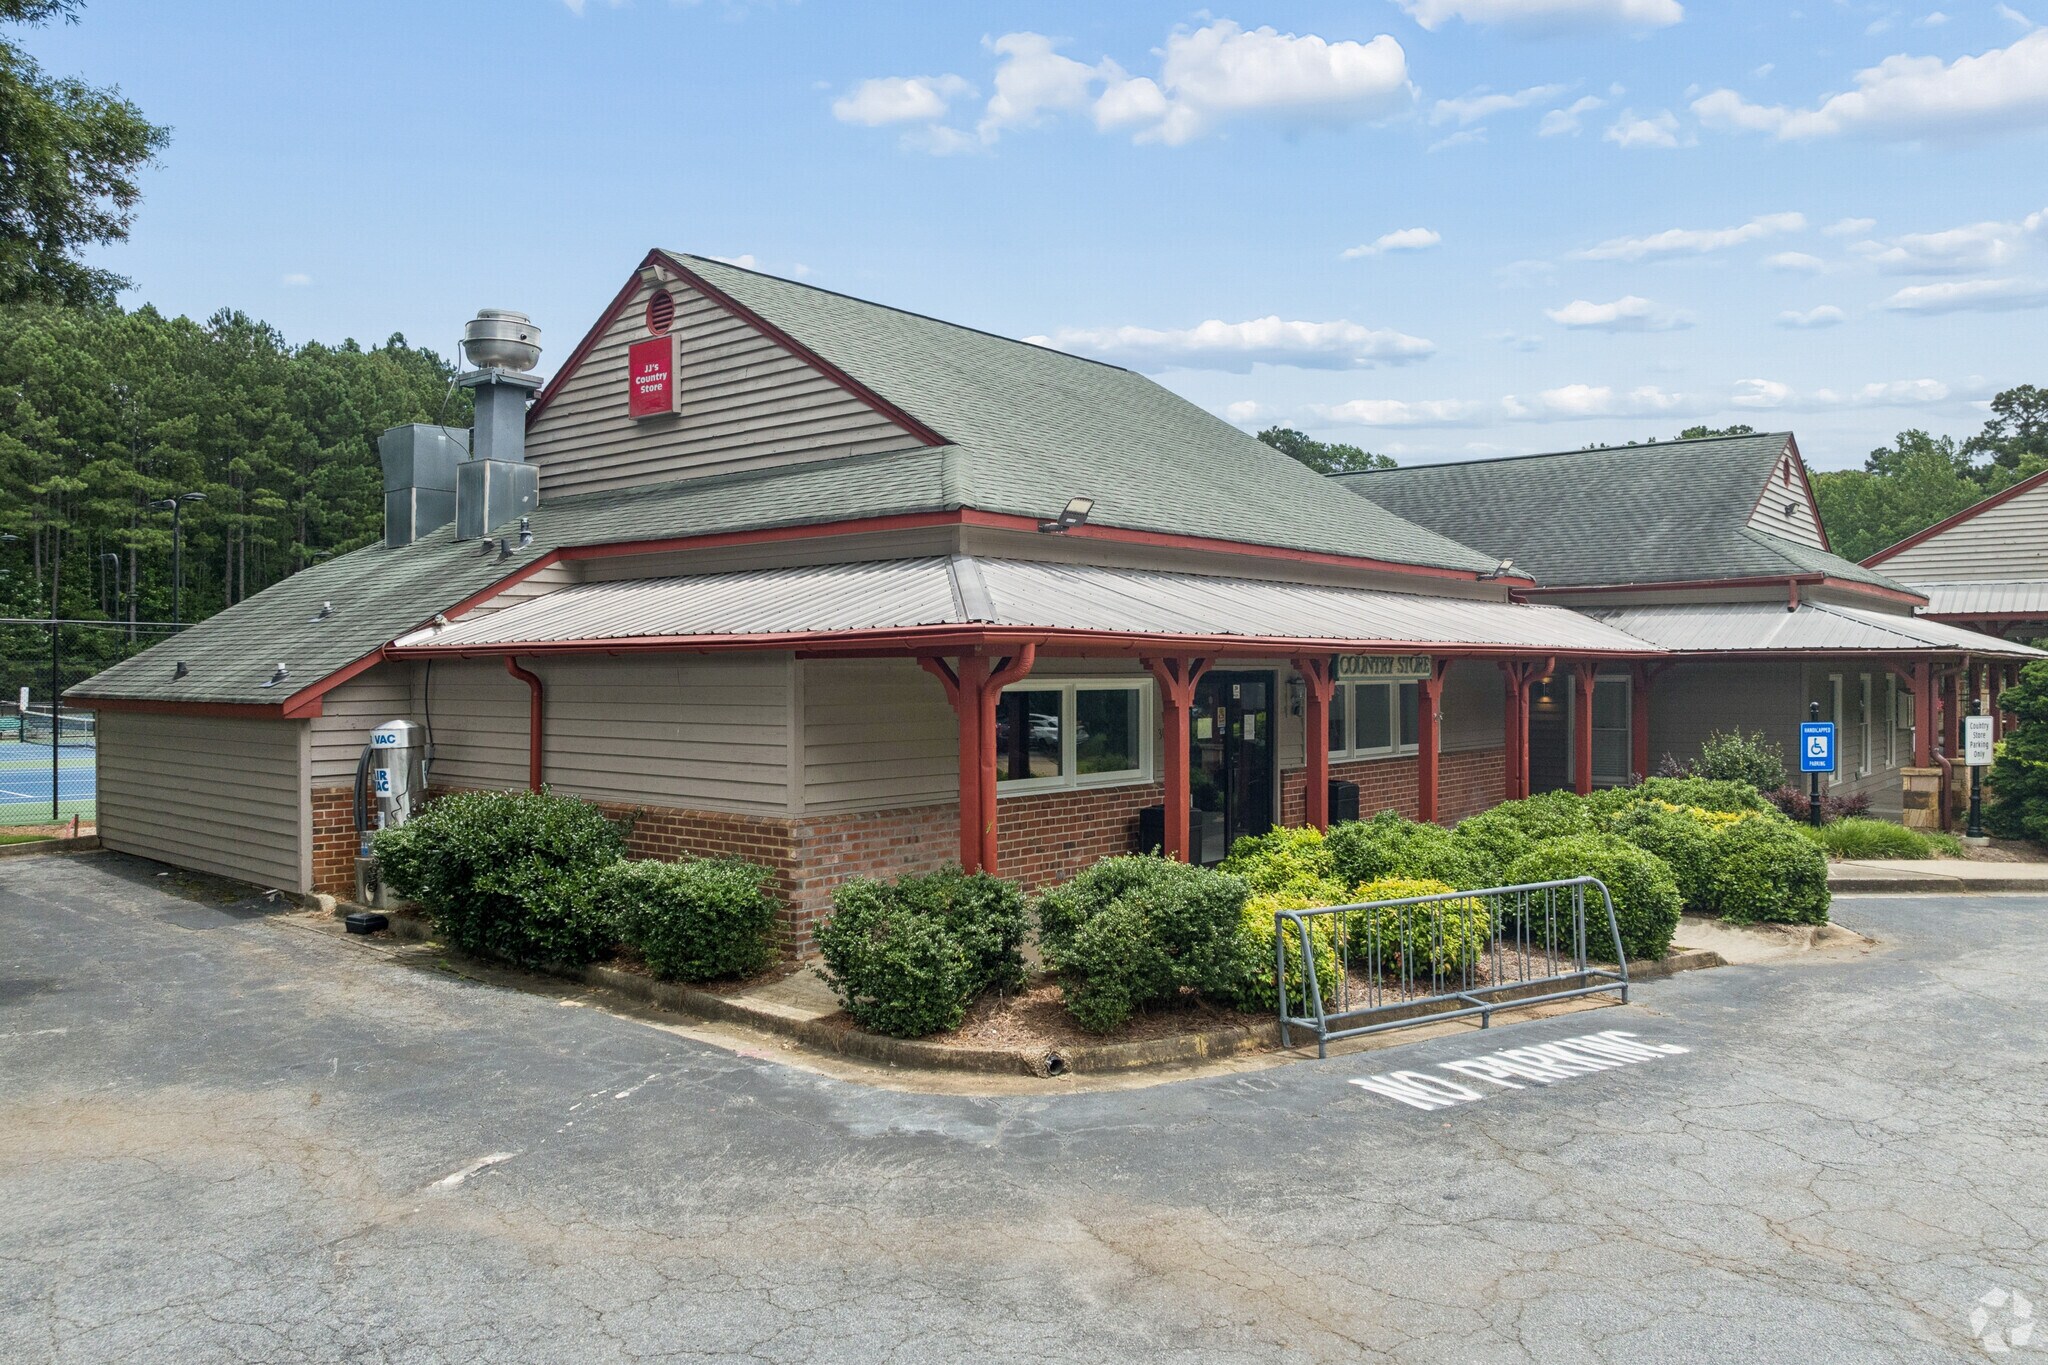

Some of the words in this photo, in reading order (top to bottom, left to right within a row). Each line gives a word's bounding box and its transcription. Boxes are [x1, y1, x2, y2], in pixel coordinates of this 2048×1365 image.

[644, 363, 659, 373] JJ's
[635, 372, 667, 385] Country
[640, 383, 663, 394] Store
[1339, 655, 1393, 675] COUNTRY
[1397, 656, 1430, 673] STORE
[1970, 722, 1989, 731] Country
[374, 734, 396, 744] VAC
[1972, 731, 1986, 739] Store
[1970, 741, 1989, 750] Parking
[1973, 750, 1985, 759] Only
[1348, 1070, 1483, 1111] NO
[1437, 1030, 1690, 1089] PARKING
